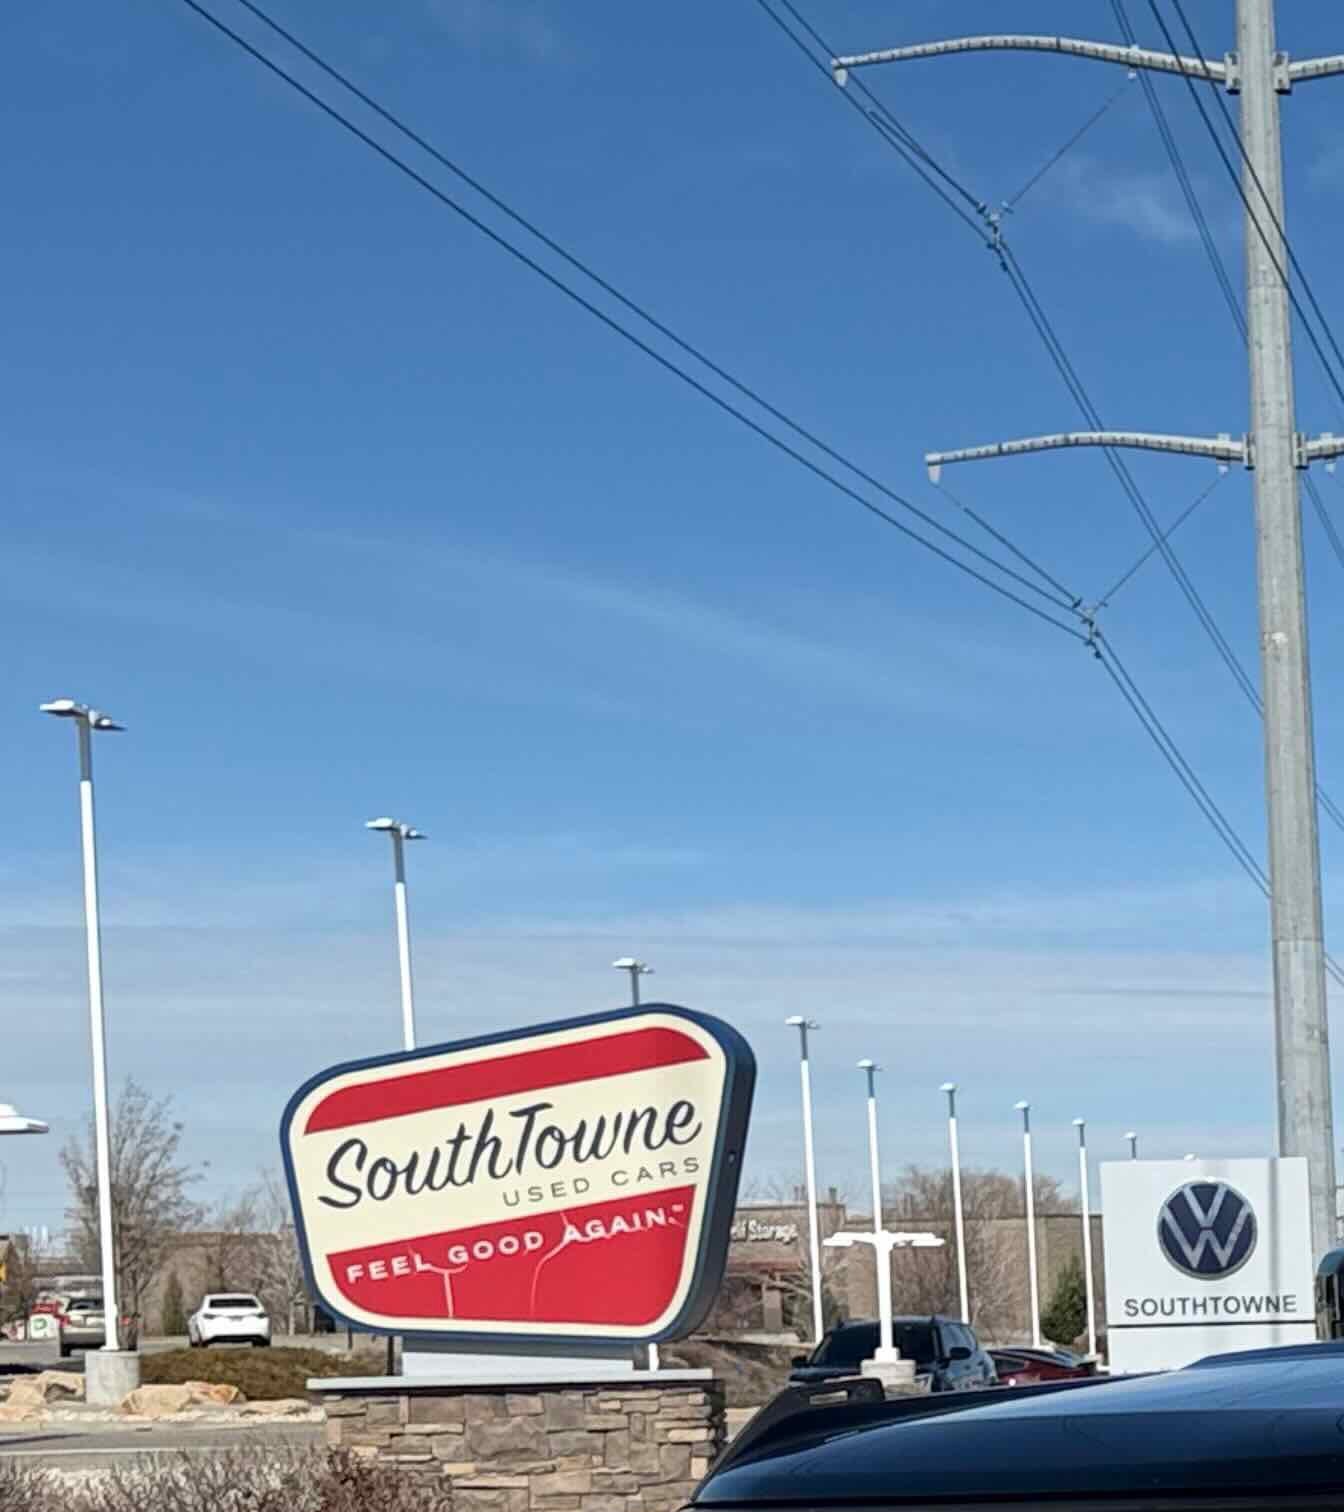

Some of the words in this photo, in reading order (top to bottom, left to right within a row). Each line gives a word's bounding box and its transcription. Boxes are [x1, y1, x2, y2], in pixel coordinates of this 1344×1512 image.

[502, 1176, 591, 1208] USED
[610, 1156, 701, 1187] CARS
[346, 1254, 434, 1284] FEEL
[447, 1231, 544, 1265] GOOD
[1123, 1295, 1297, 1318] SOUTHTOWNE
